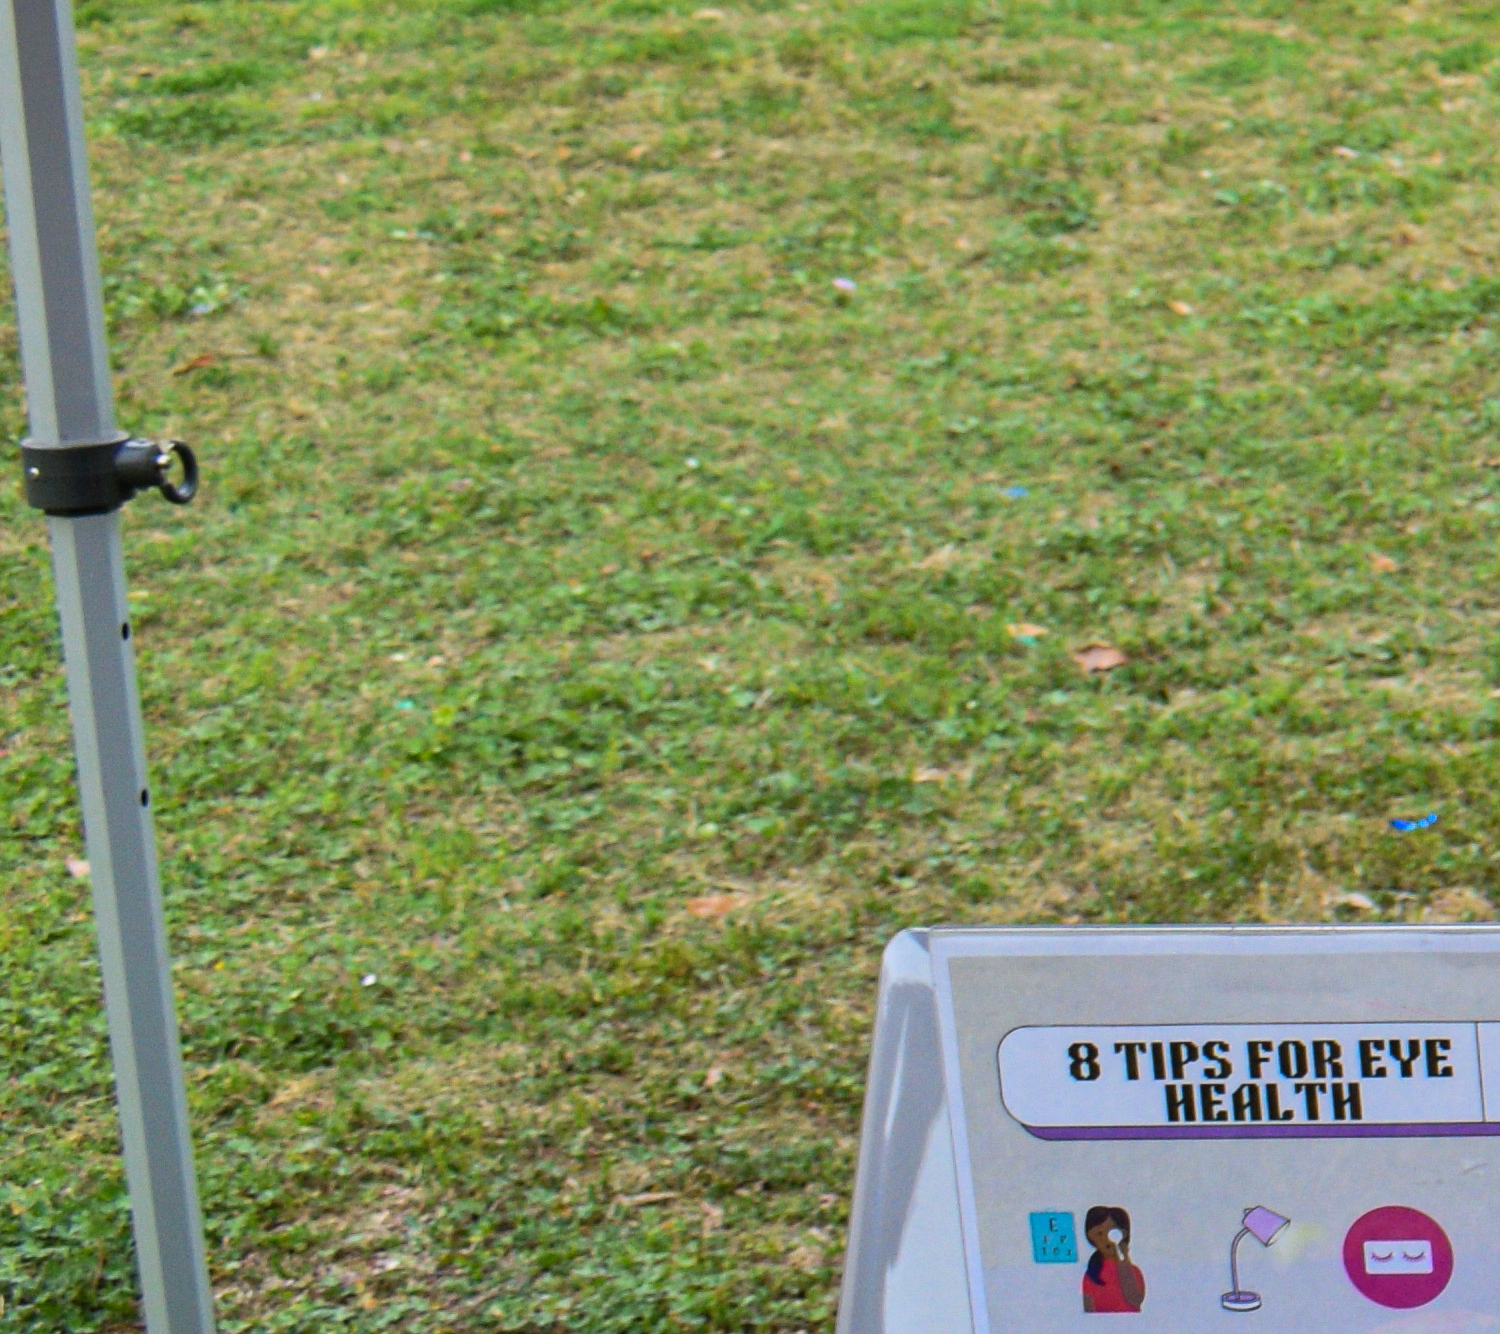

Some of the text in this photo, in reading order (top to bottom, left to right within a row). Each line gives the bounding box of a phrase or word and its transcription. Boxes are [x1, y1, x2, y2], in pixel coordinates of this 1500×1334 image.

[1068, 1038, 1454, 1081] 8 TIPS FOR EYE
[1164, 1081, 1363, 1122] HEALTH
